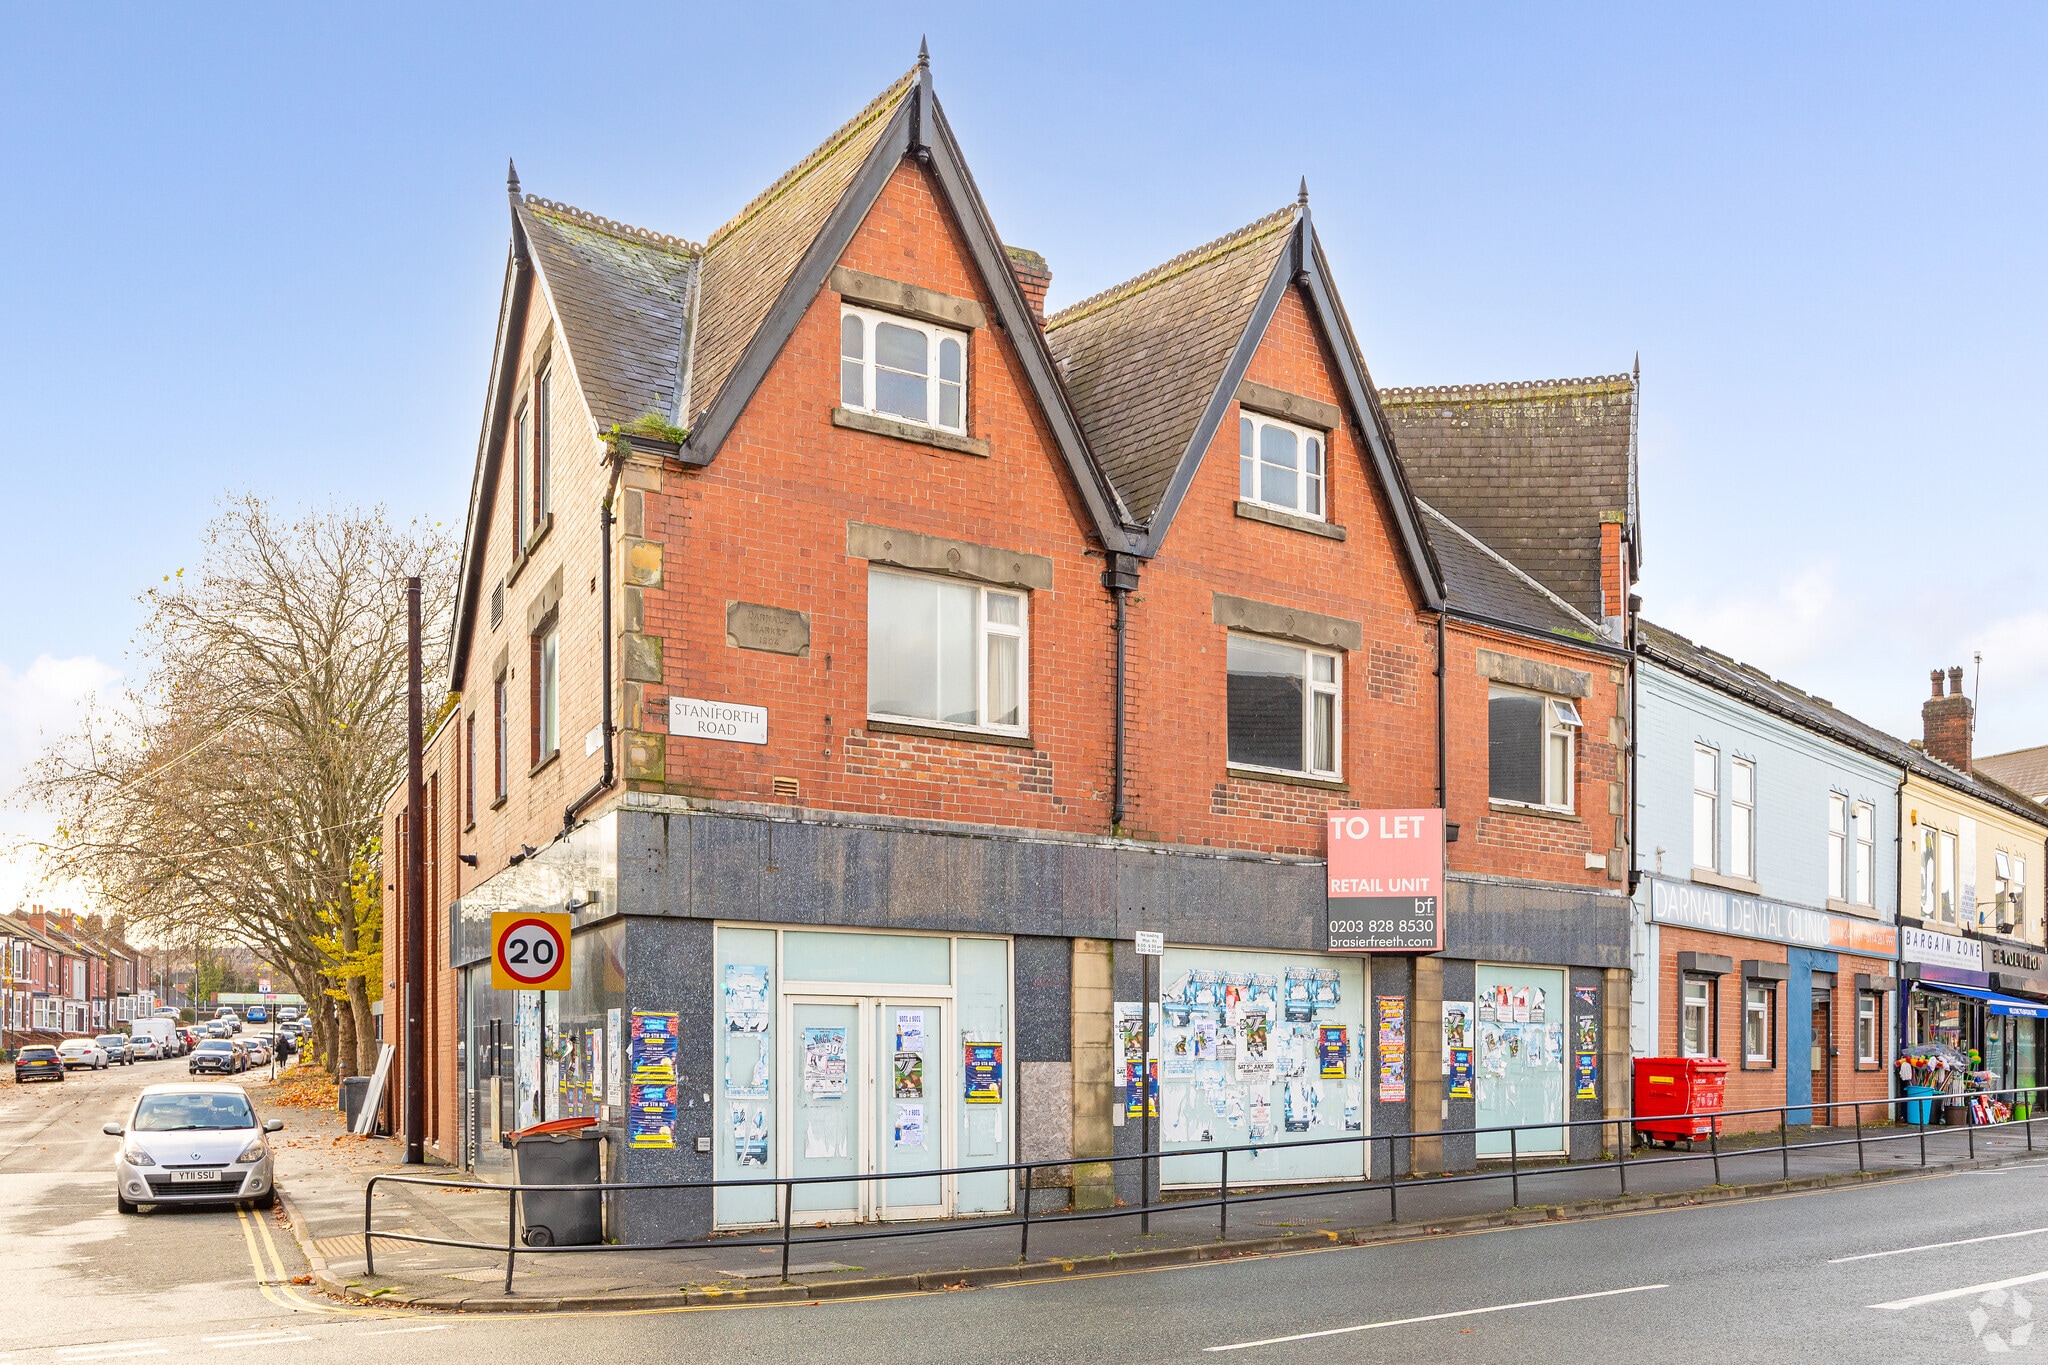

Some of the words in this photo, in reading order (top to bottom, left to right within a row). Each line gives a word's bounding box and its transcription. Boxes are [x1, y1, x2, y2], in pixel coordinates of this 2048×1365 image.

[674, 703, 760, 724] STANIFORTH
[698, 720, 737, 736] ROAD
[1330, 816, 1370, 840] TO
[1380, 816, 1425, 839] LET
[1331, 879, 1384, 893] RETAIL
[1388, 878, 1430, 892] UNIT
[1655, 882, 1727, 928] DARNALL
[1732, 898, 1784, 938] DENTAL
[1787, 908, 1831, 946] CLINIC
[1330, 920, 1364, 932] 0203
[1368, 920, 1394, 932] 828
[1398, 920, 1434, 932] 8530
[1330, 935, 1433, 948] brasierfreeth.com
[1906, 930, 1951, 952] BARGAIN
[1957, 940, 1980, 958] ZONE
[508, 938, 554, 964] 20
[198, 1172, 214, 1180] SSU
